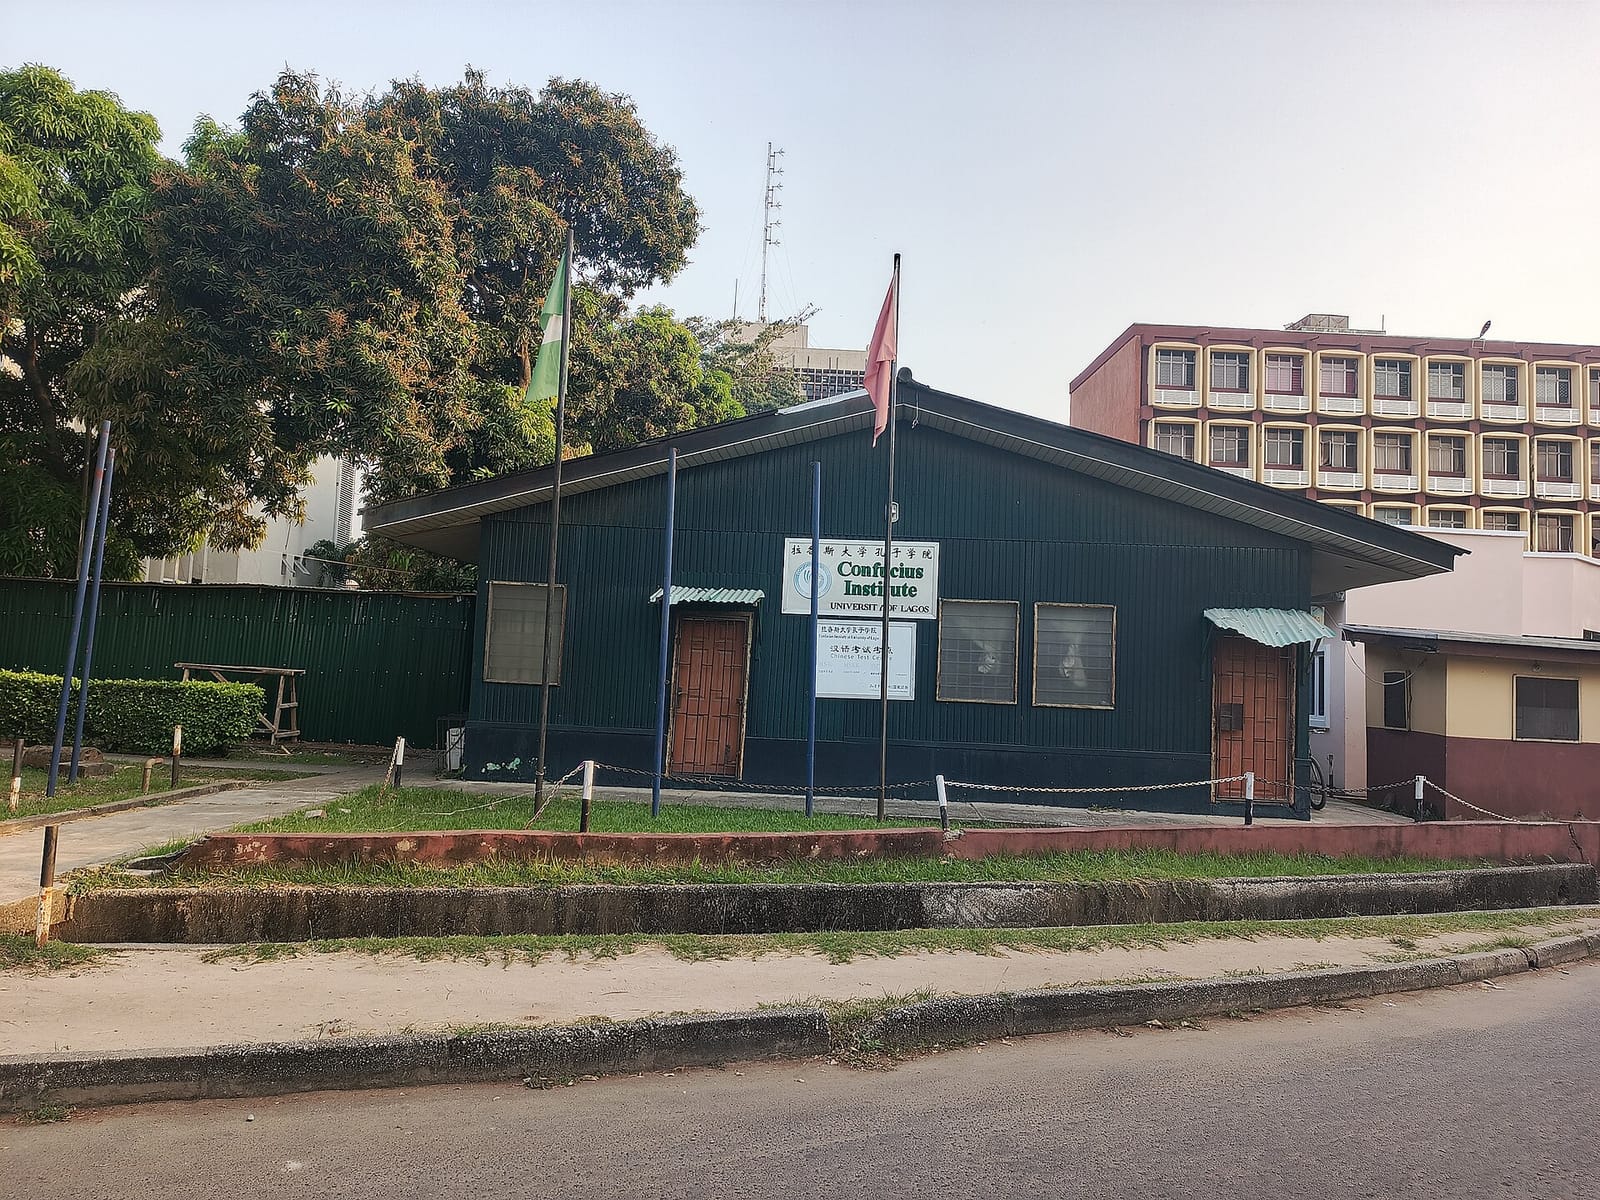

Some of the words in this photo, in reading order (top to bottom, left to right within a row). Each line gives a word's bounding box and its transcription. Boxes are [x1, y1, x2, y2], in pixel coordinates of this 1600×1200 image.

[837, 561, 924, 579] Confucius
[844, 580, 918, 598] Instiute
[900, 605, 930, 613] LAGOS
